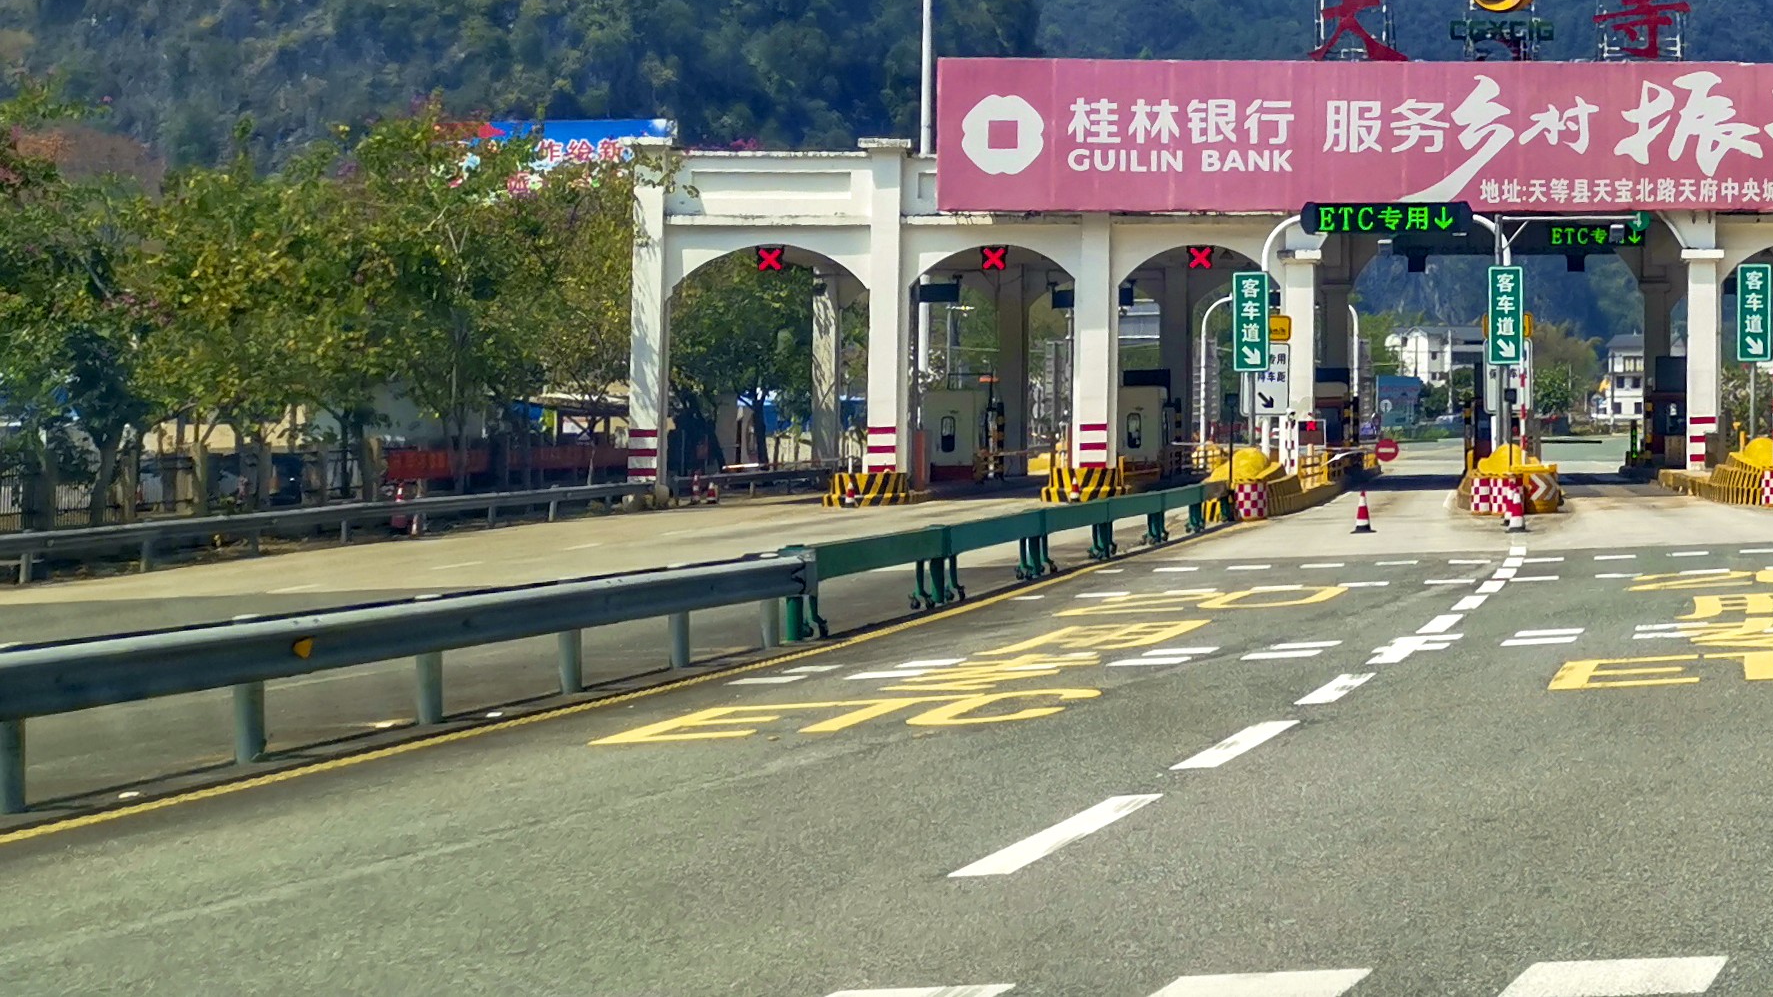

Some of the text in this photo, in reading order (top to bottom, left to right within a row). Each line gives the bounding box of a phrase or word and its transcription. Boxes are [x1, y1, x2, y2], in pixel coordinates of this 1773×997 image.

[1067, 97, 1295, 145] 桂林银行
[1067, 147, 1293, 172] GUILIN BANK
[1318, 205, 1429, 231] ETC专用
[1241, 278, 1261, 343] 客车道
[1496, 273, 1515, 336] 客车道
[1744, 270, 1764, 334] 客车道
[975, 619, 1212, 656] 用
[588, 688, 1102, 745] ETC
